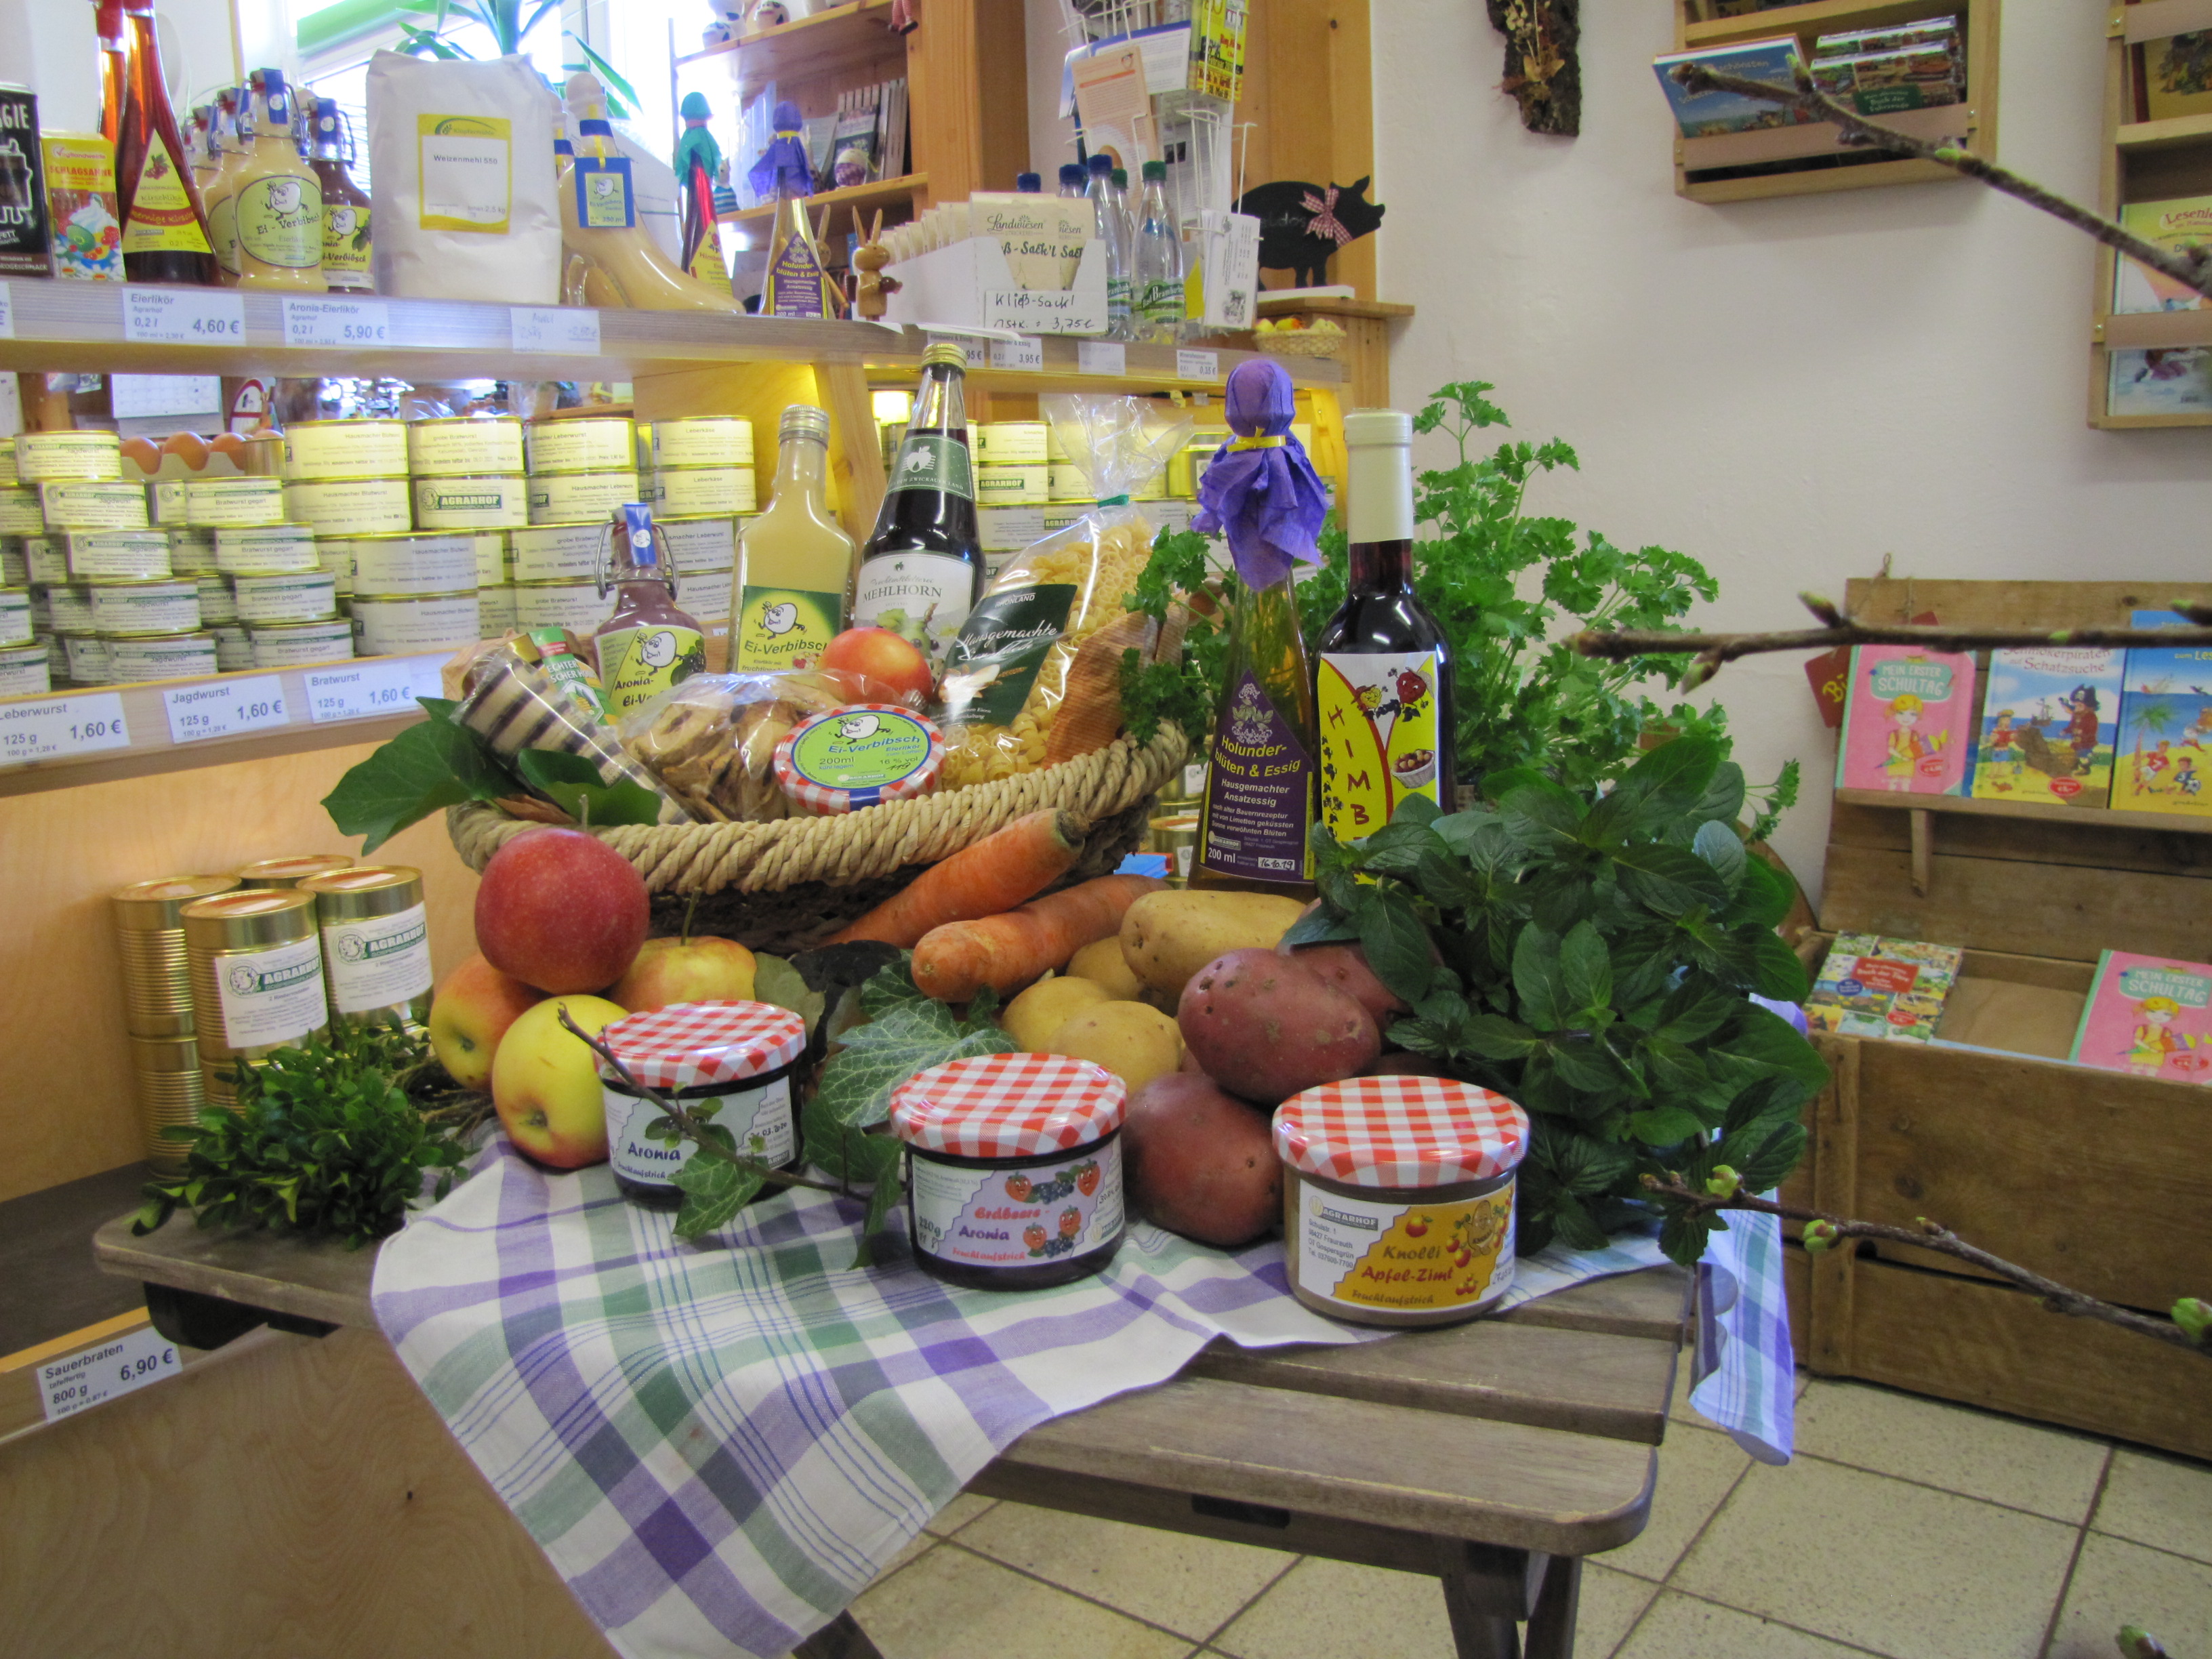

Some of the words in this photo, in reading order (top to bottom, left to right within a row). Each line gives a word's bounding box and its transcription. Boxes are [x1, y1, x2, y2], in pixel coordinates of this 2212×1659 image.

[0, 104, 30, 129] GIE
[433, 155, 482, 164] Weizenmehl
[483, 157, 498, 165] 550
[256, 224, 269, 235] Ei
[987, 213, 1044, 232] Landwiesen
[776, 268, 798, 277] blüten
[781, 260, 815, 270] Holunder-
[130, 293, 175, 305] Eierlikör
[133, 306, 163, 314] Agrarhof
[289, 303, 360, 314] Aronia-Eierlikör
[134, 316, 150, 328] 0,2
[192, 319, 226, 335] 4,60
[230, 320, 240, 335] €
[293, 325, 306, 335] 0,2
[344, 325, 373, 340] 5,90
[376, 326, 385, 339] €
[977, 351, 982, 360] €
[1019, 353, 1033, 364] 3,95
[1036, 354, 1040, 364] €
[948, 482, 964, 491] LAND
[980, 479, 1023, 488] AGRARHOF
[248, 498, 266, 506] gegart
[441, 495, 500, 506] AGRARHOF
[274, 546, 293, 554] gegart
[863, 584, 943, 603] MEHLHORN
[956, 619, 1057, 648] Hausgemachte
[277, 646, 308, 655] Bratwurst
[309, 644, 330, 653] gegart
[546, 660, 577, 673] ECHTER
[1882, 665, 1906, 675] MEIN
[1909, 665, 1942, 677] ERSTER
[2024, 657, 2105, 674] Schatzsuche
[312, 672, 361, 687] Bratwurst
[615, 678, 654, 691] Aronia-
[1878, 677, 1945, 697] SCHULTAG
[172, 687, 230, 705] Jagdwurst
[317, 698, 335, 709] 125
[337, 698, 344, 708] g
[369, 688, 398, 705] 1,60
[401, 686, 410, 700] €
[180, 715, 199, 727] 125
[202, 715, 209, 726] g
[237, 702, 268, 721] 1,60
[272, 699, 283, 714] €
[3, 733, 26, 745] 125
[29, 734, 38, 745] g
[70, 721, 106, 741] 1,60
[110, 719, 122, 735] €
[183, 729, 195, 737] 100
[208, 726, 221, 734] 1,28
[7, 748, 20, 757] 100
[36, 745, 51, 754] 1,28
[827, 735, 920, 754] Ei-Verbibsch
[885, 743, 920, 752] Eierlikör
[1221, 735, 1288, 758] Holunder-
[819, 756, 855, 764] 200ml
[1214, 747, 1245, 776] blüten
[1249, 764, 1261, 777] &
[1264, 759, 1301, 777] Essig
[1221, 778, 1290, 794] Hausgemachter
[1224, 792, 1277, 808] Ansatzessig
[1223, 806, 1235, 814] alter
[1236, 808, 1288, 819] Bauernrezeptur
[1212, 819, 1226, 830] Sonne
[1227, 825, 1262, 836] verwöhnten
[1263, 829, 1287, 837] Blüten
[1229, 815, 1256, 825] Limetten
[1256, 819, 1294, 828] geküssten
[1208, 847, 1222, 861] 200
[1223, 853, 1236, 863] ml
[367, 924, 425, 951] AGRARHOF
[2135, 970, 2162, 981] MEIN
[2169, 974, 2205, 987] ERSTER
[2128, 979, 2207, 1004] SCHULTAG
[628, 1141, 681, 1161] Aronia
[974, 1206, 1042, 1221] Erdbeere
[1322, 1208, 1377, 1226] AGRARHOF
[958, 1225, 1010, 1241] Aronia
[1324, 1233, 1353, 1249] Fraureuth
[951, 1246, 1026, 1262] Fruchtaufstrich
[1382, 1245, 1441, 1260] Knolli
[1361, 1265, 1454, 1284] Apfel-Zimt
[1352, 1289, 1434, 1306] Fruchtaufstrich
[45, 1343, 123, 1380] Sauerbraten
[48, 1371, 86, 1389] tafelfertig
[120, 1354, 157, 1381] 6,90
[161, 1348, 173, 1365] €
[53, 1387, 76, 1405] 800
[80, 1384, 88, 1397] g
